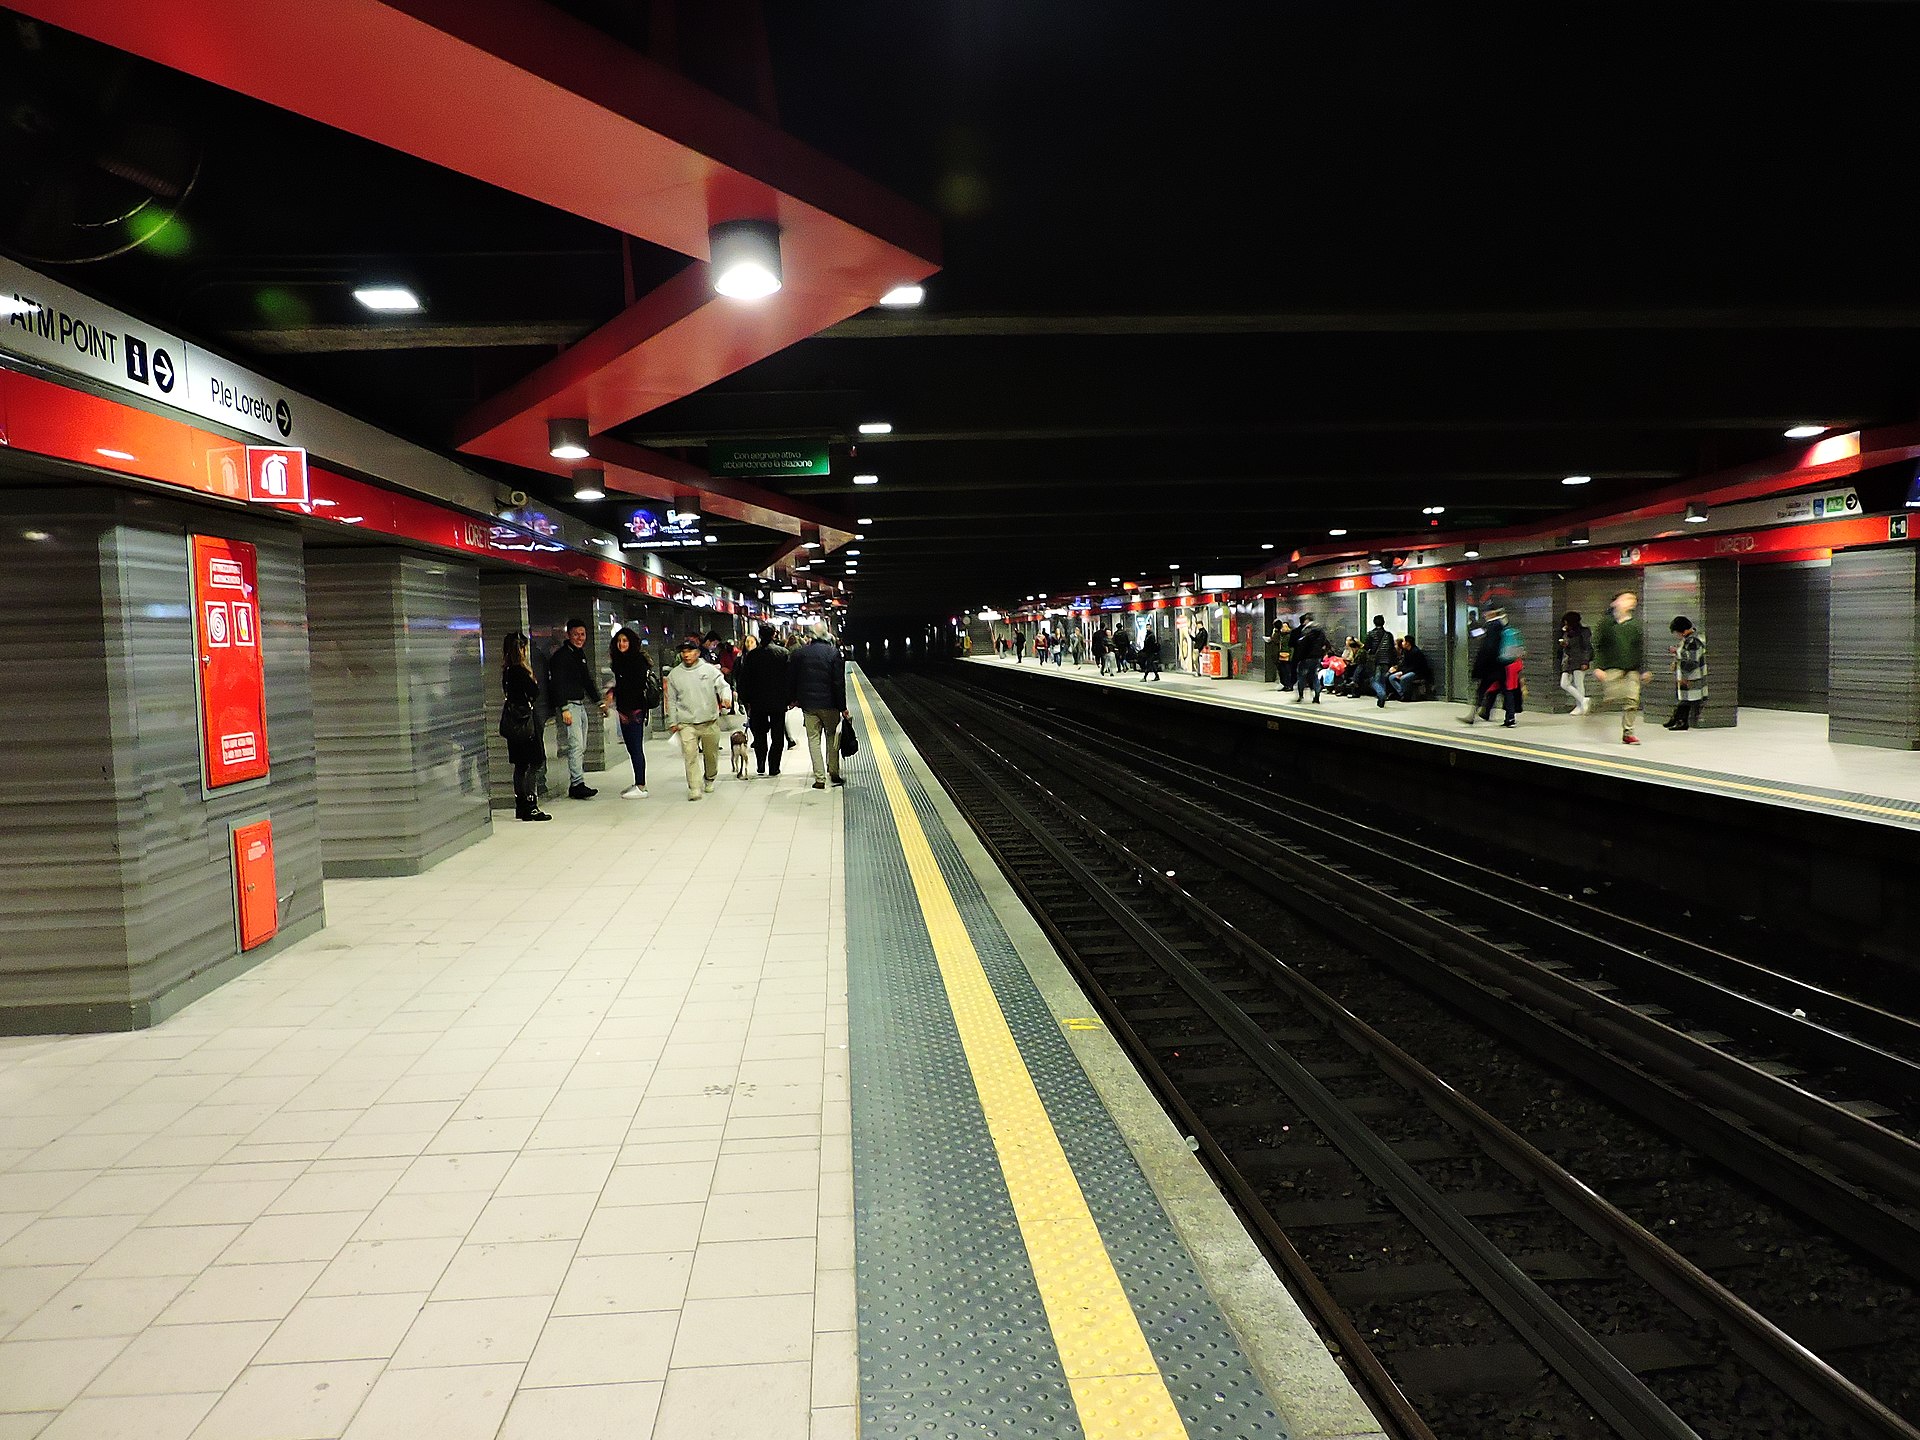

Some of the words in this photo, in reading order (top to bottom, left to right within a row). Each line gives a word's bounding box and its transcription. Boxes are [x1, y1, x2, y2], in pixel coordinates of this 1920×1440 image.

[10, 293, 55, 341] ATM
[60, 310, 117, 364] POINT
[211, 377, 232, 408] P.le
[235, 387, 272, 423] Loreto
[781, 459, 813, 468] stazione
